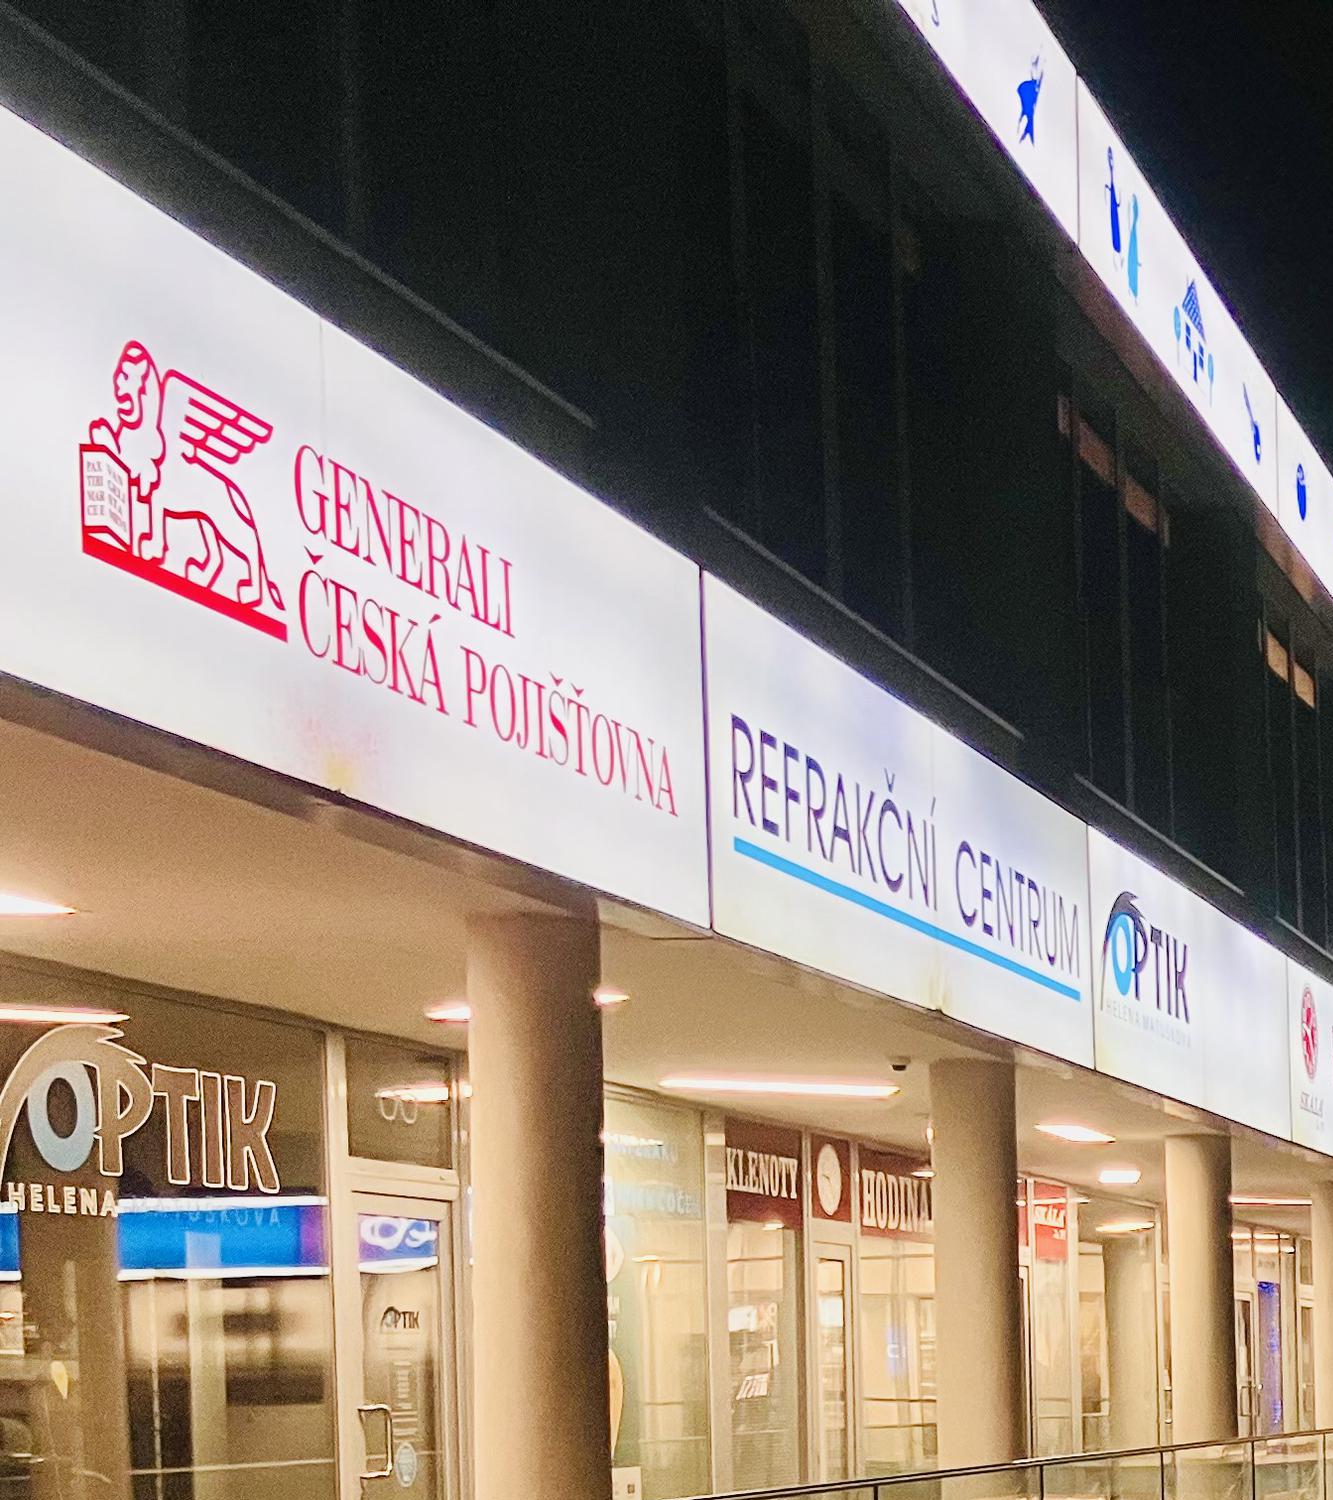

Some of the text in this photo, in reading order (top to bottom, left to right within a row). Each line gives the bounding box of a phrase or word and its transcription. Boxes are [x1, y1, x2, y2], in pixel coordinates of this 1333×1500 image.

[293, 444, 516, 639] GENERALI
[298, 544, 679, 818] ČESKÁ POJIŠŤOVNA
[729, 711, 1082, 979] REFRAKČNÍ CENTRUM
[1107, 905, 1191, 1024] OPTIK
[22, 1046, 281, 1194] OPTIK
[725, 1146, 799, 1200] KLENOTY
[8, 1181, 119, 1218] HELENA
